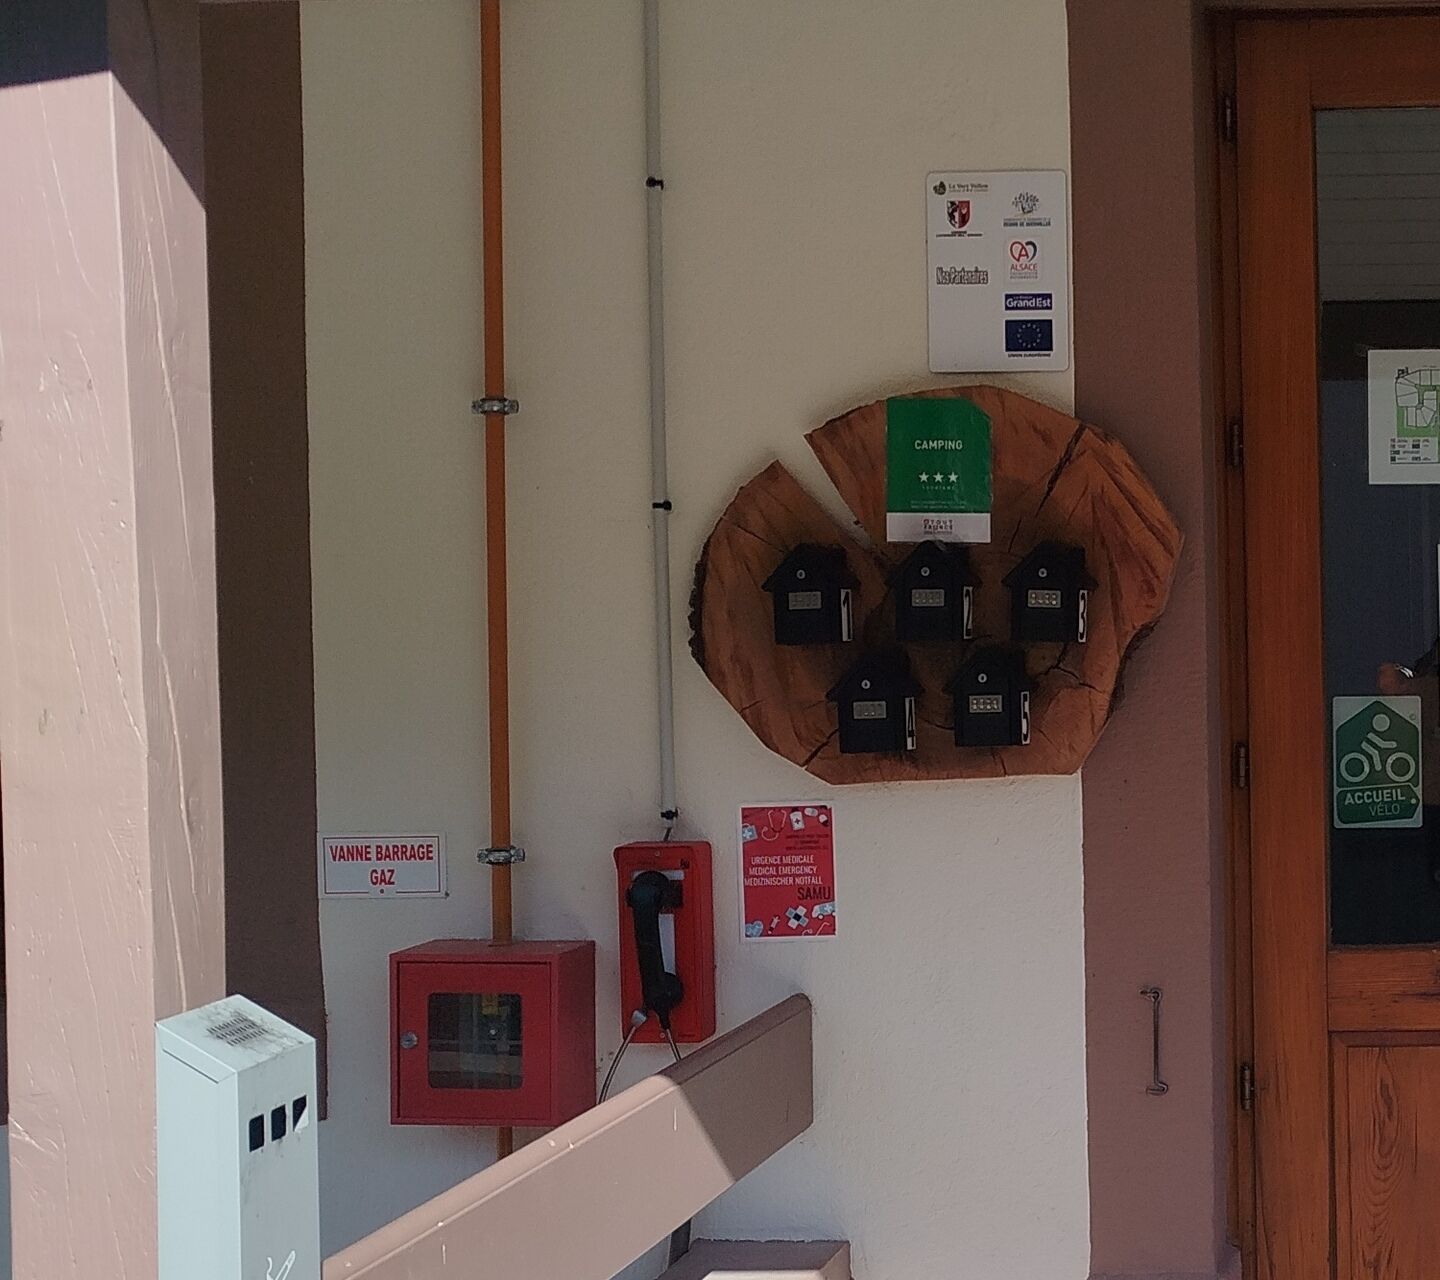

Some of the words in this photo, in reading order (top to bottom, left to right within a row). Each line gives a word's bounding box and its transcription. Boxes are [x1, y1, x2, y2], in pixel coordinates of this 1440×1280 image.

[1010, 263, 1038, 271] ALSACE
[936, 266, 950, 285] Nos
[950, 265, 988, 285] Partenaires
[1006, 297, 1035, 308] Grand
[1036, 297, 1051, 308] Est
[914, 439, 963, 450] CAMPING
[963, 586, 973, 638] 2
[1078, 590, 1087, 641] 3
[907, 697, 916, 748] 4
[1022, 692, 1030, 742] 5
[1344, 789, 1406, 805] ACCUEIL
[1369, 802, 1401, 816] VÉLO
[329, 844, 371, 862] VANNE
[375, 844, 434, 861] BARRAGE
[751, 855, 782, 865] URGENCE
[782, 854, 814, 864] MEDICALE
[370, 868, 395, 886] GAZ
[748, 866, 777, 875] MEDICAL
[778, 865, 817, 875] EMERGENCY
[744, 876, 794, 886] MEDIZINISCHER
[795, 875, 823, 885] NOTFALL
[797, 886, 831, 900] SAMU
